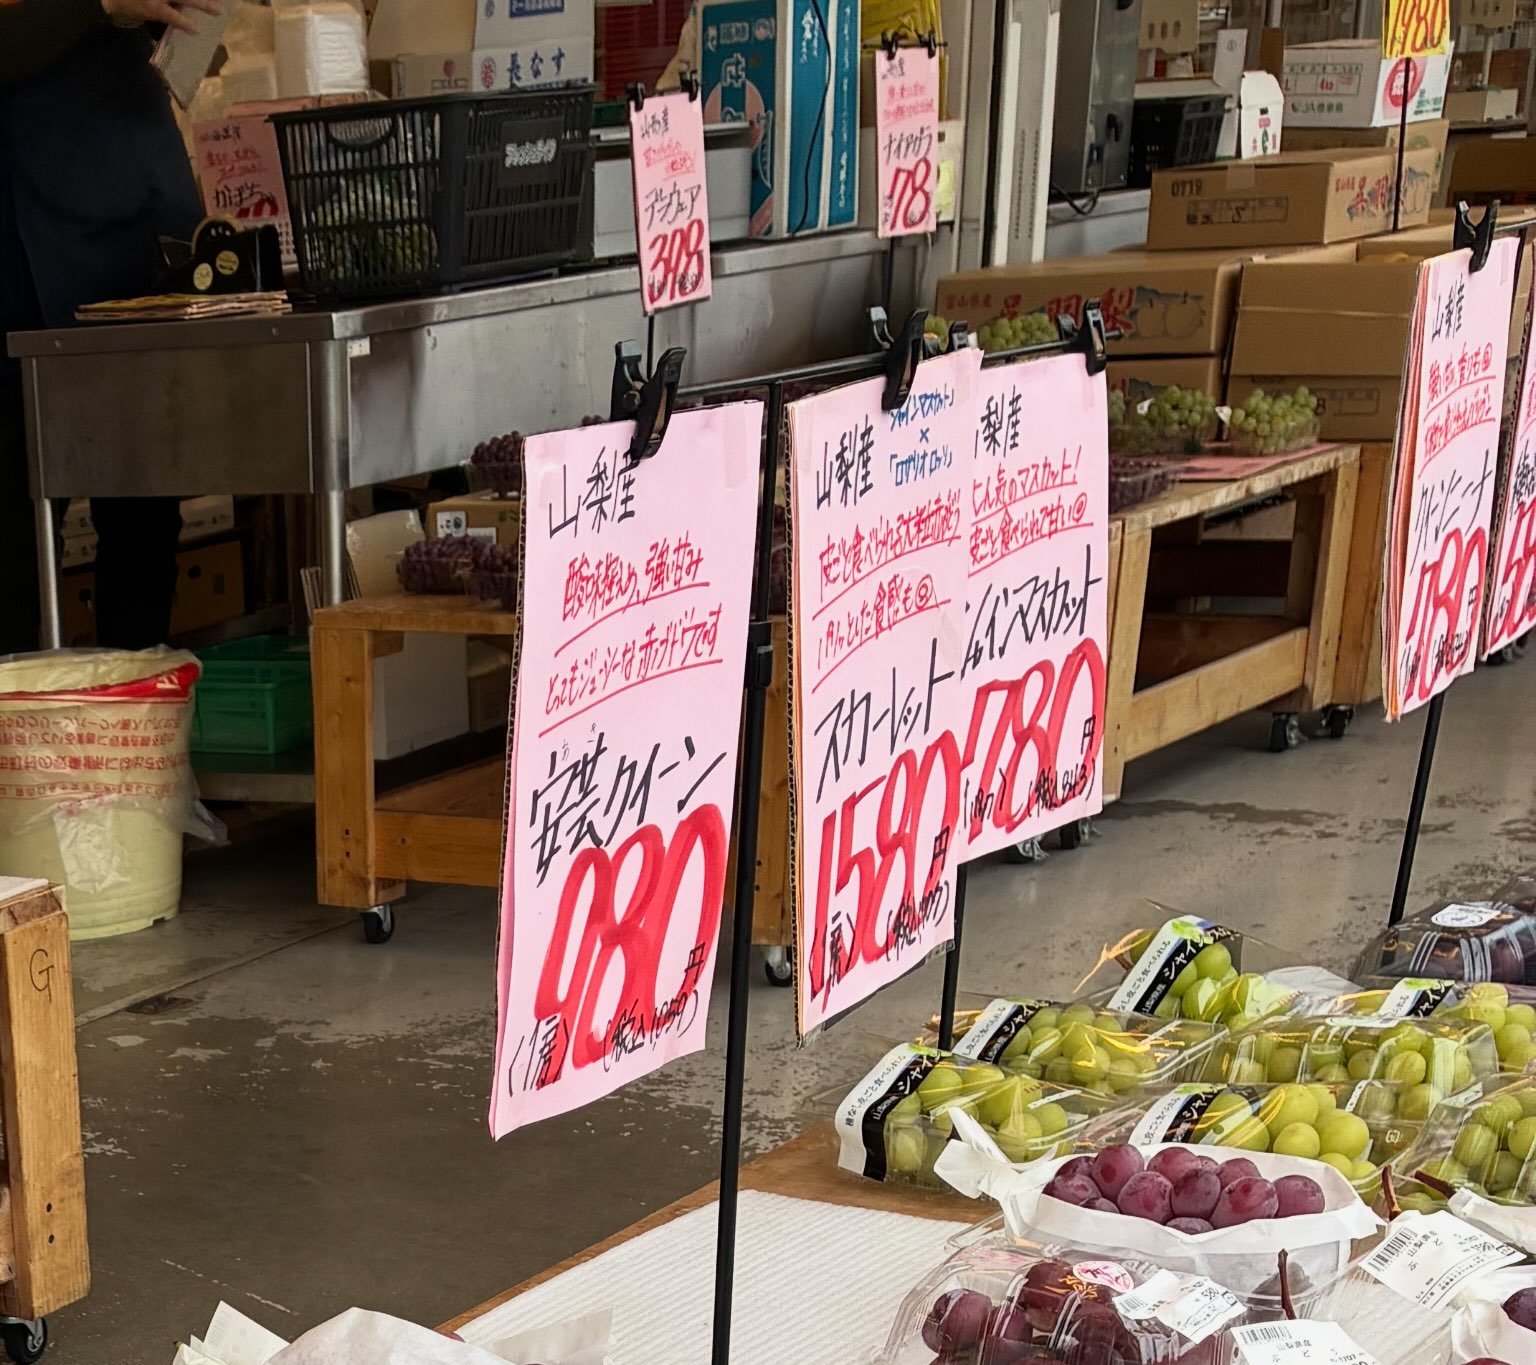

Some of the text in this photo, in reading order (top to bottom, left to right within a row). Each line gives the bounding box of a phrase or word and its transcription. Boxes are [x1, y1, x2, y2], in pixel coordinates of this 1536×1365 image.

[507, 46, 566, 83] 長なす
[646, 218, 705, 305] 398
[1431, 272, 1466, 342] 山梨産
[549, 446, 637, 540] 山梨産
[816, 414, 875, 511] 山梨産
[815, 637, 955, 804] スカーレット
[529, 731, 728, 889] 安芸クイーン
[931, 826, 952, 884] 円
[534, 803, 728, 1091] 980
[682, 942, 707, 985] 円
